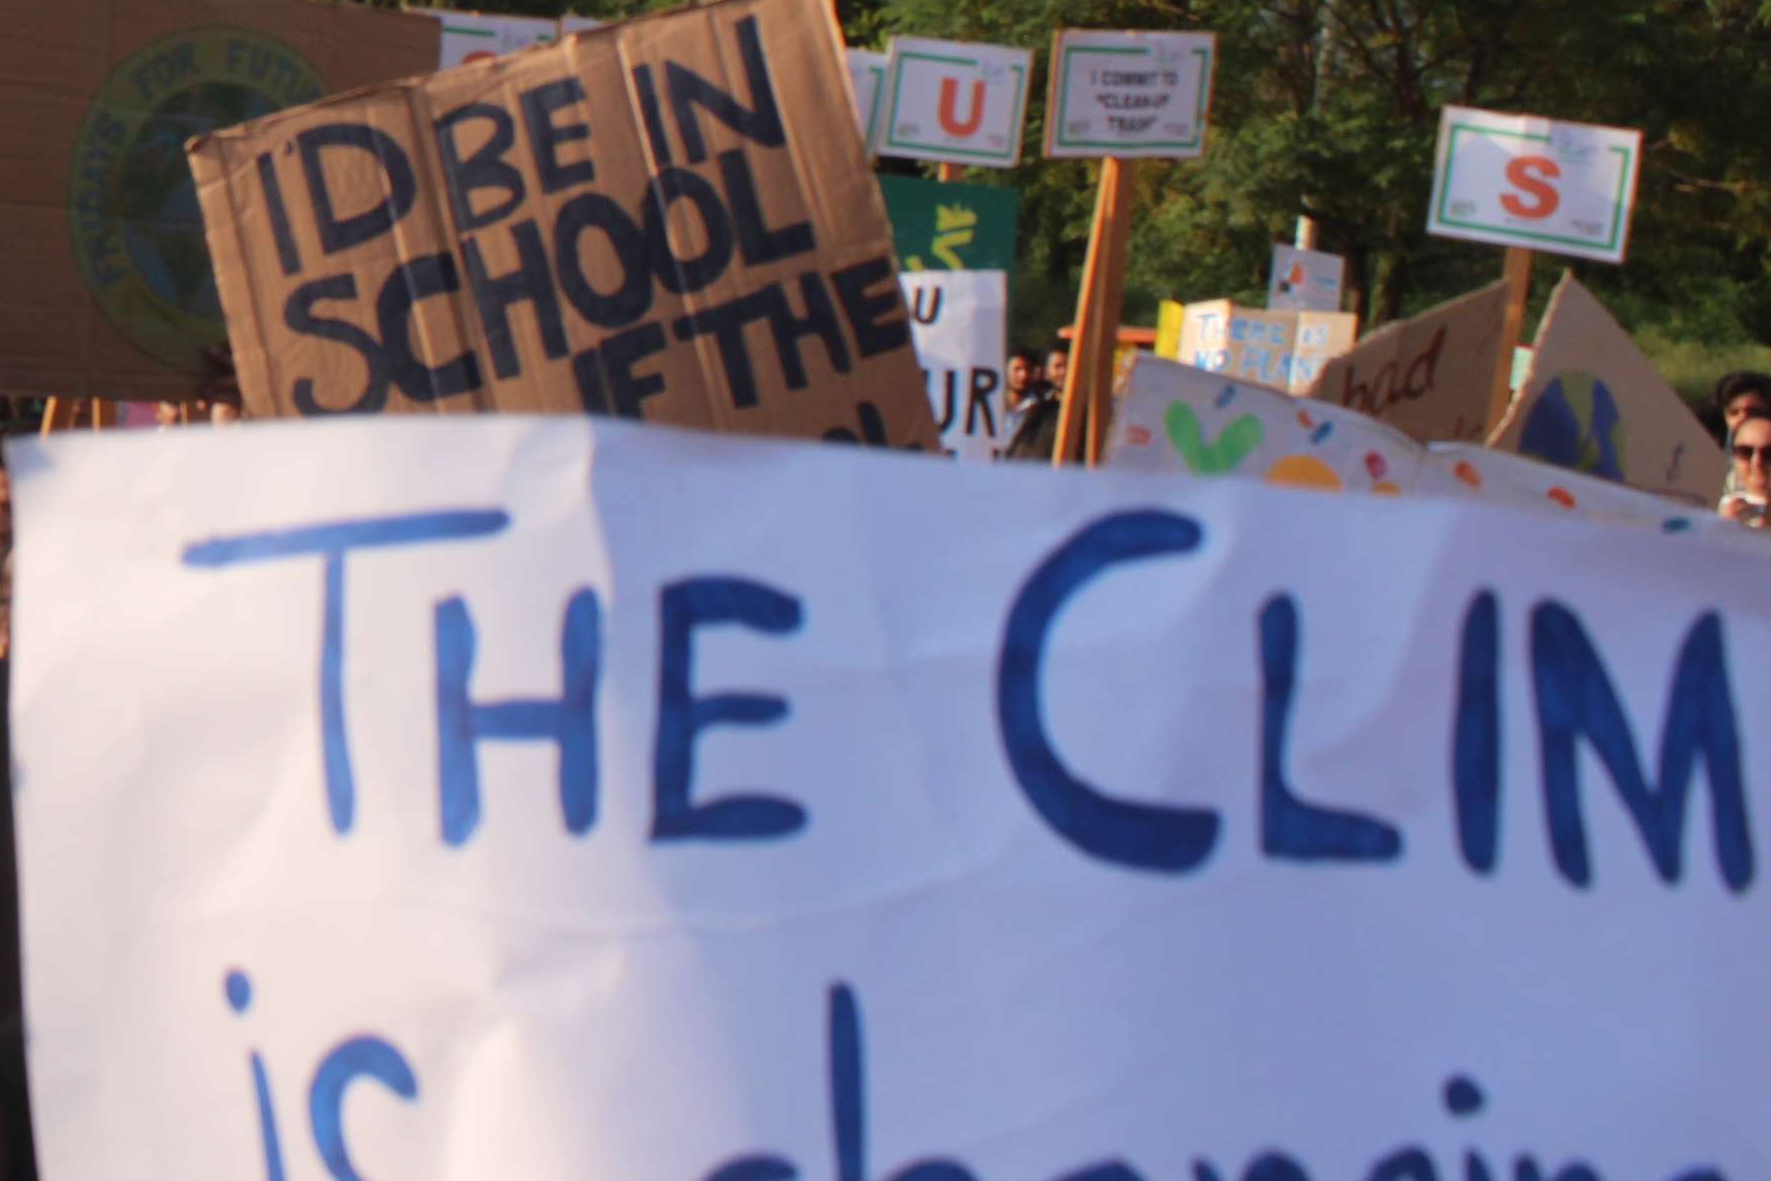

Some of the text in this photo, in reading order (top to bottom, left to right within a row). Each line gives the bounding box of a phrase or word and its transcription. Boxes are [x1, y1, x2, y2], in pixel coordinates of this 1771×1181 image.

[229, 39, 325, 107] FUTU
[434, 76, 596, 234] BE
[630, 13, 788, 169] IN
[938, 77, 987, 137] U
[1498, 154, 1563, 221] S
[283, 146, 816, 417] SCHOOL
[572, 256, 912, 423] IF THE
[180, 505, 1756, 895] THE CLIM
